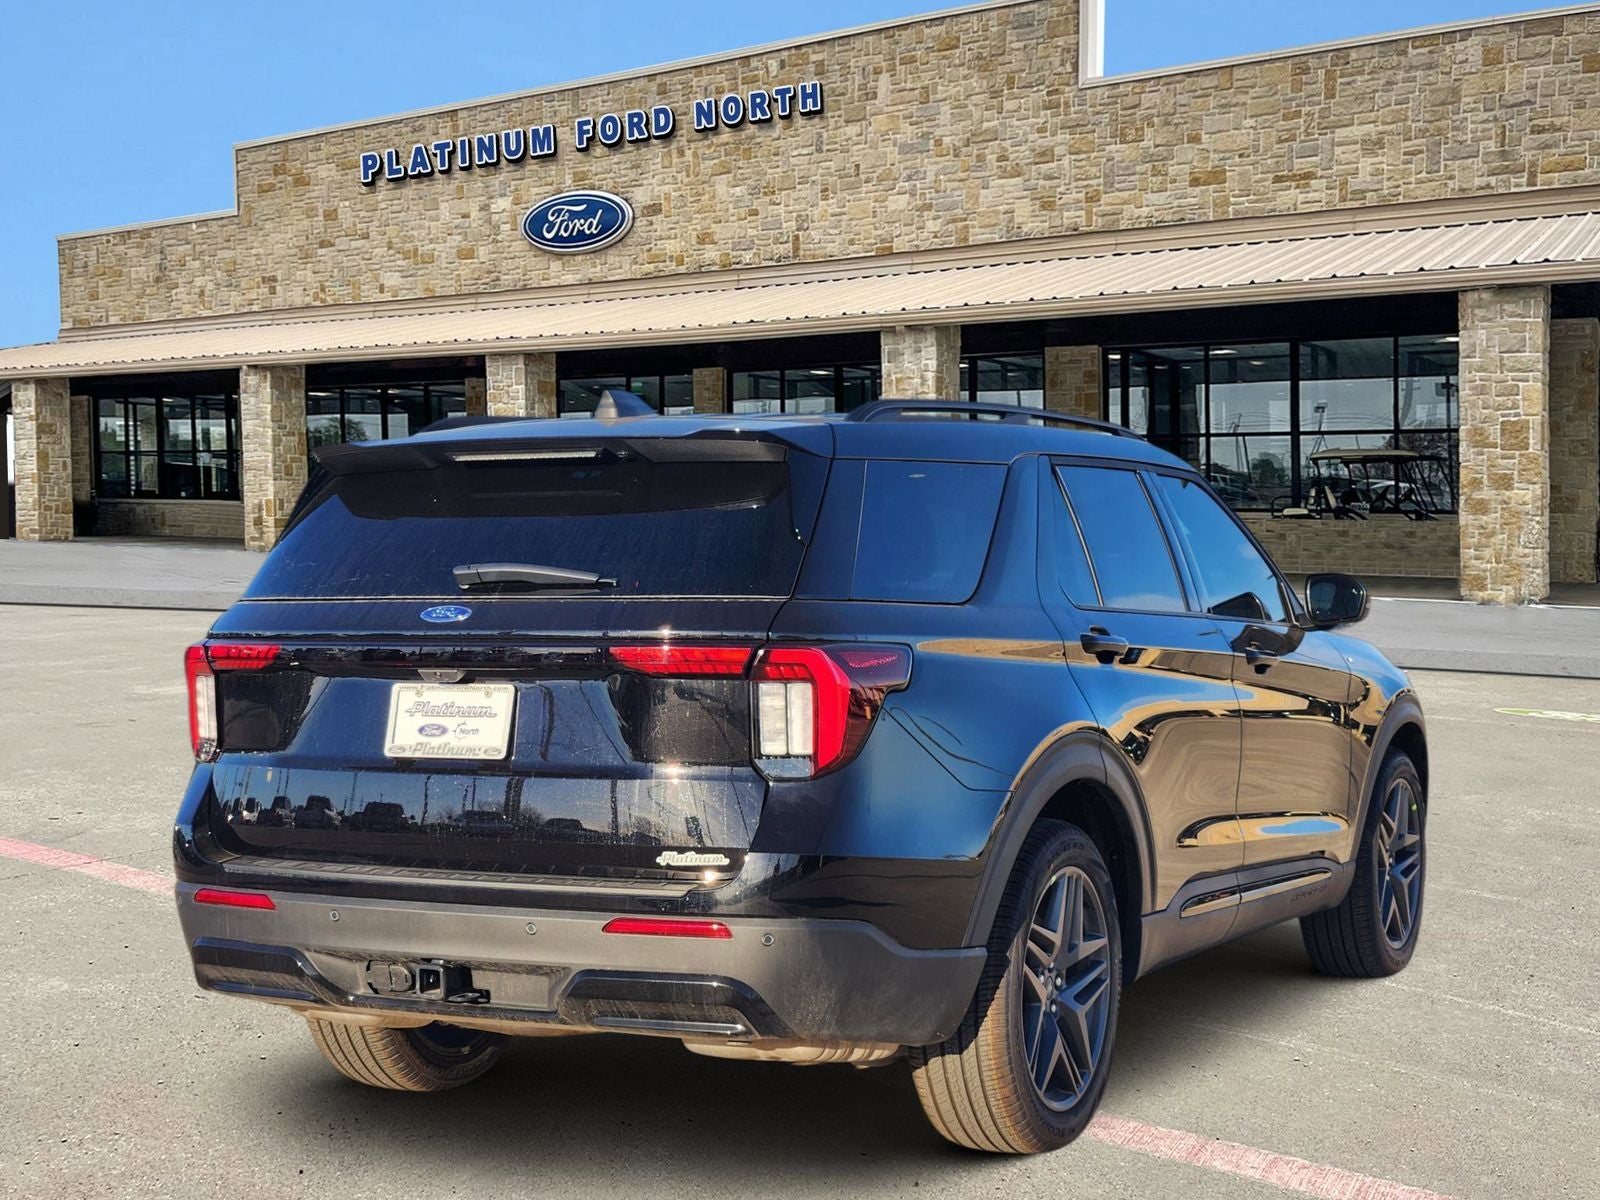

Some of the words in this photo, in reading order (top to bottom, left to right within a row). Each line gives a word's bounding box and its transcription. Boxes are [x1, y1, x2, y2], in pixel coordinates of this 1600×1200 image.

[360, 125, 557, 186] PLATINUM
[575, 105, 674, 152] FORD
[694, 82, 824, 133] NORTH
[541, 203, 603, 240] Ford
[404, 701, 498, 718] Platinum
[459, 726, 480, 736] North
[656, 851, 730, 866] Platinum
